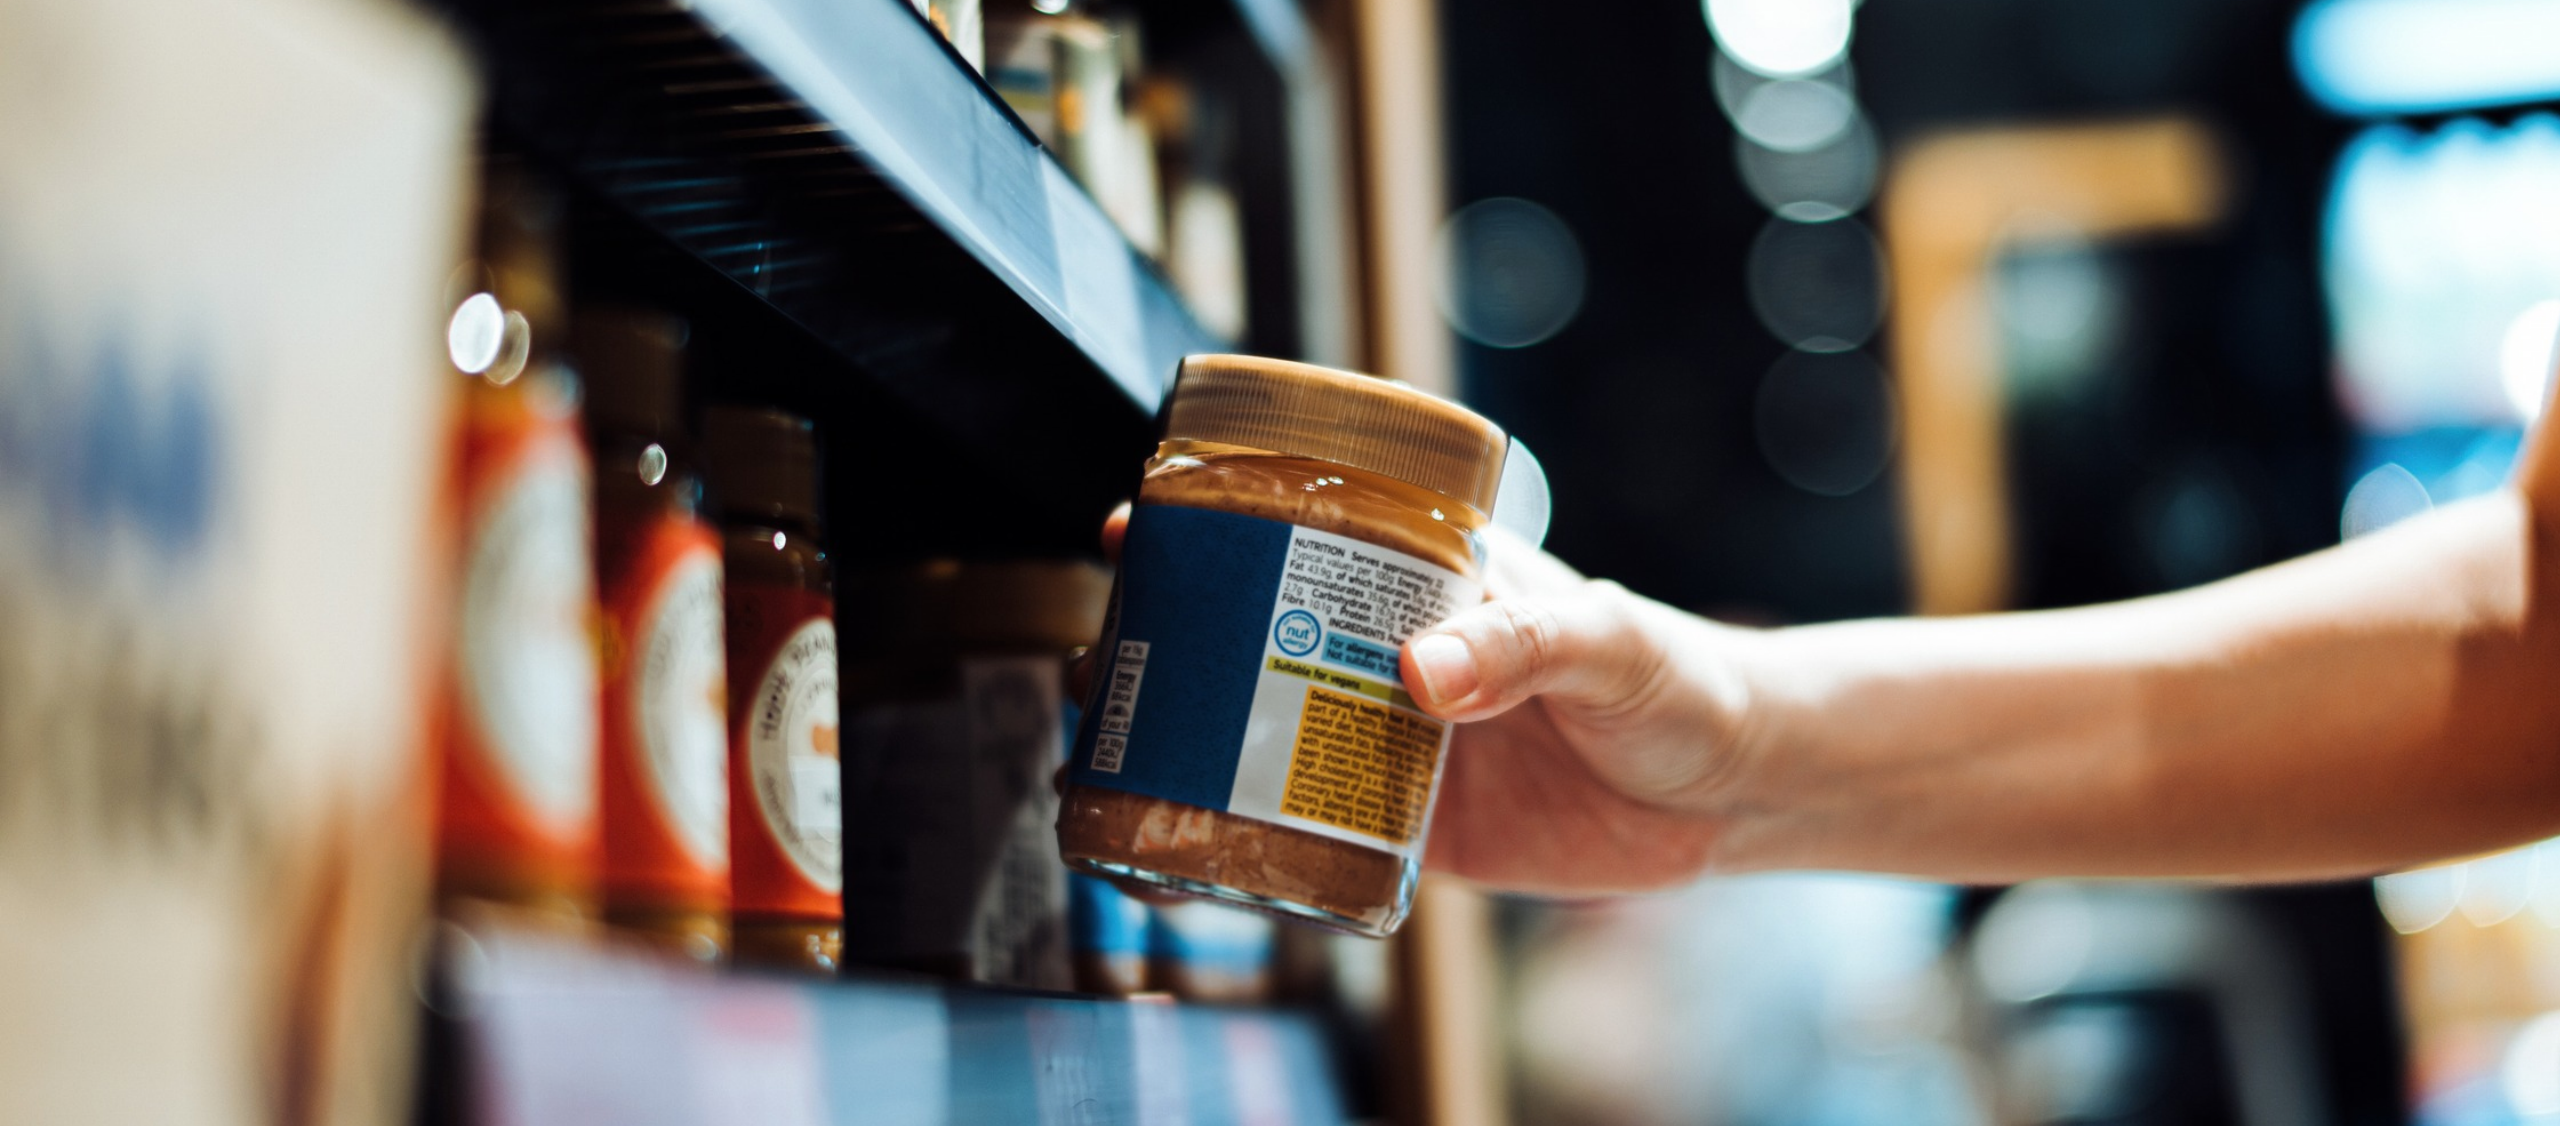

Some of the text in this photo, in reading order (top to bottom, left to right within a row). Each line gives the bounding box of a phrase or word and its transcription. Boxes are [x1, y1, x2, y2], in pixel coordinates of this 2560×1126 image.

[1293, 549, 1324, 564] Typical
[1327, 558, 1354, 572] values
[1357, 566, 1372, 577] per
[1376, 570, 1394, 584] 100g
[1398, 577, 1422, 594] Energy
[1294, 538, 1345, 557] NUTRITION
[1352, 552, 1380, 567] Serves
[1382, 562, 1434, 584] approximately
[1290, 560, 1304, 571] Fat
[1336, 572, 1346, 580] of
[1348, 576, 1372, 588] which
[1376, 583, 1410, 600] saturates
[1287, 572, 1364, 597] monounsaturates
[1392, 600, 1402, 608] of
[1403, 604, 1422, 615] which
[1282, 593, 1305, 606] Fibre
[1308, 600, 1332, 614] 10.1g
[1340, 606, 1371, 623] Protein
[1284, 582, 1304, 596] 2.7g
[1312, 588, 1372, 611] Carbohydrate
[1399, 614, 1408, 622] of
[1409, 617, 1426, 629] which
[1286, 625, 1310, 640] nut
[1329, 618, 1386, 641] INGREDIENTS
[1328, 649, 1342, 660] Not
[1346, 654, 1376, 670] suitable
[1330, 637, 1344, 648] For
[1346, 642, 1384, 660] allergens
[1116, 670, 1137, 684] Energy
[1274, 660, 1360, 690] Suitable for vegans
[1308, 702, 1326, 713] part
[1329, 707, 1339, 717] of
[1312, 690, 1357, 710] Deliciously
[1306, 714, 1333, 726] varied
[1303, 723, 1353, 744] unsaturated
[1298, 746, 1321, 758] been
[1323, 753, 1350, 766] shown
[1301, 735, 1319, 746] with
[1322, 740, 1370, 759] unsaturated
[1293, 768, 1348, 790] development
[1296, 757, 1316, 769] High
[1319, 764, 1363, 781] cholesterol
[1291, 779, 1331, 796] Coronary
[1333, 791, 1354, 801] heart
[1286, 802, 1305, 813] may
[1319, 811, 1337, 822] may
